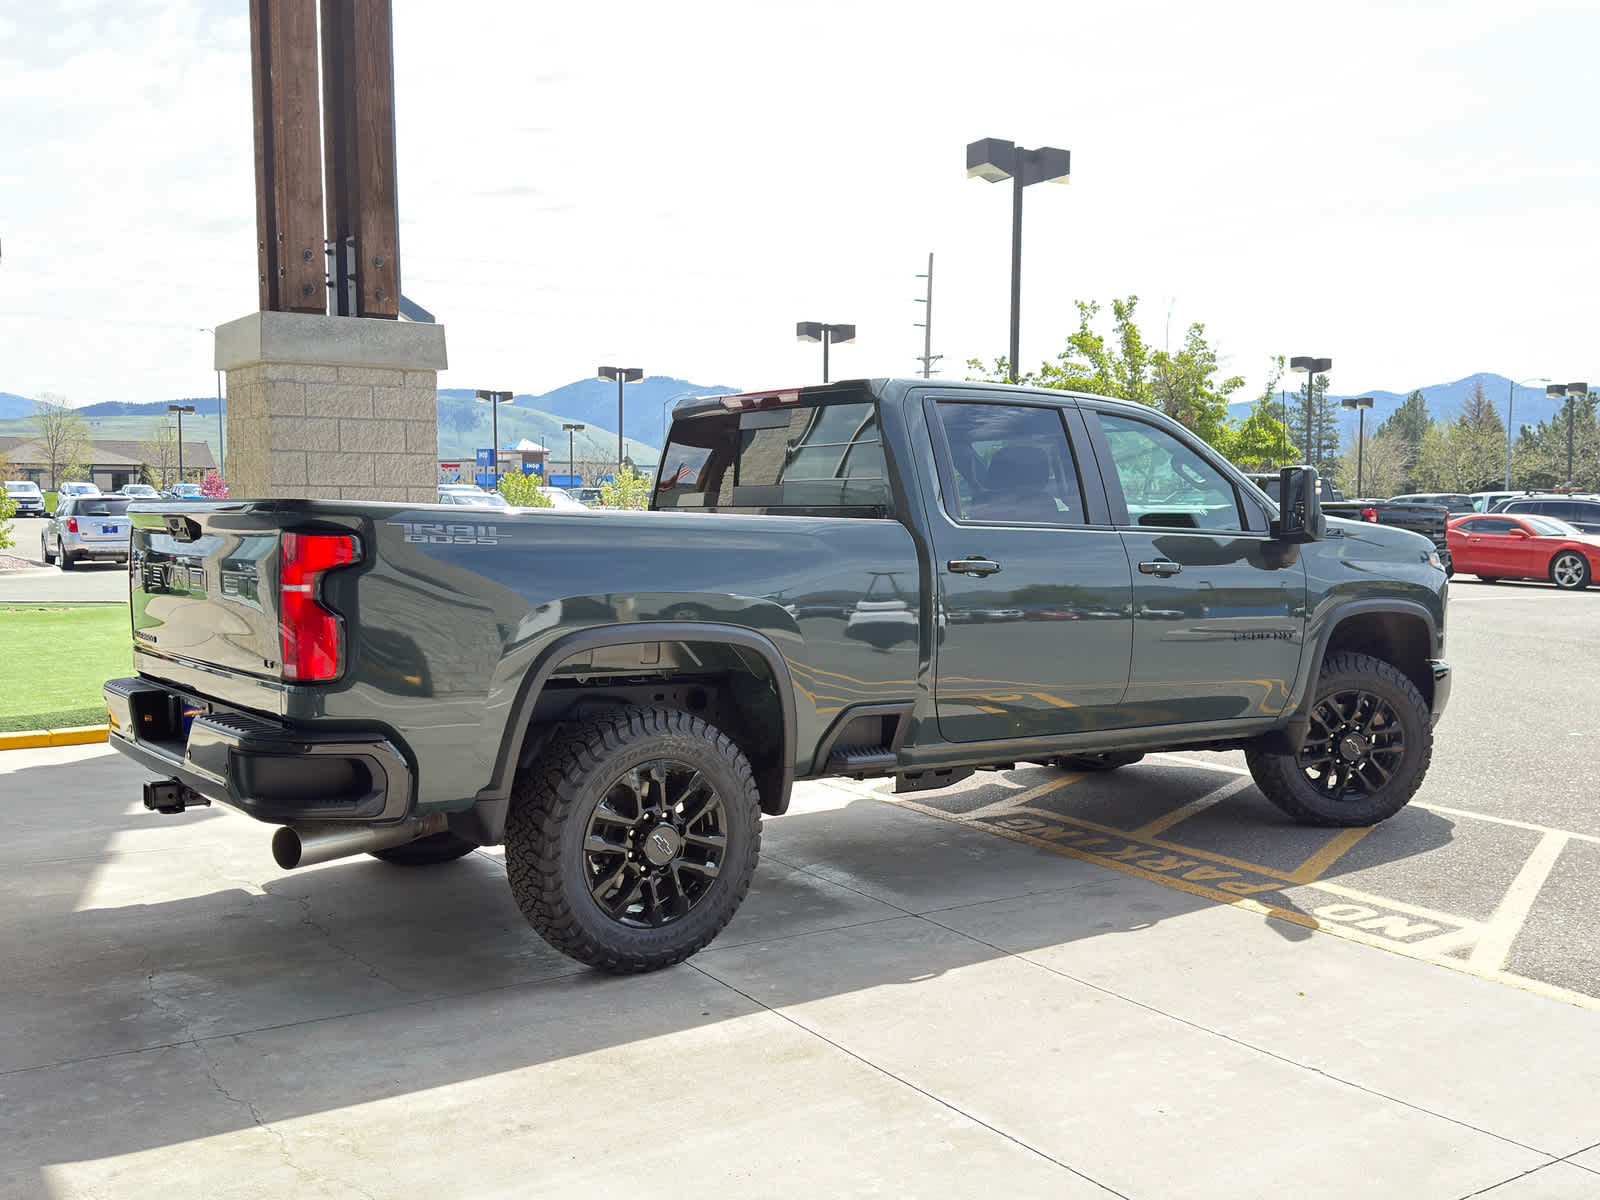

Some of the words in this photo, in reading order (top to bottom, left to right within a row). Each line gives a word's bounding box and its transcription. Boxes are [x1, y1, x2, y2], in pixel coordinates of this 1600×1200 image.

[388, 522, 510, 537] TRAIL
[404, 535, 498, 545] BOSS
[995, 818, 1285, 895] PARKING
[1314, 903, 1442, 939] NO
